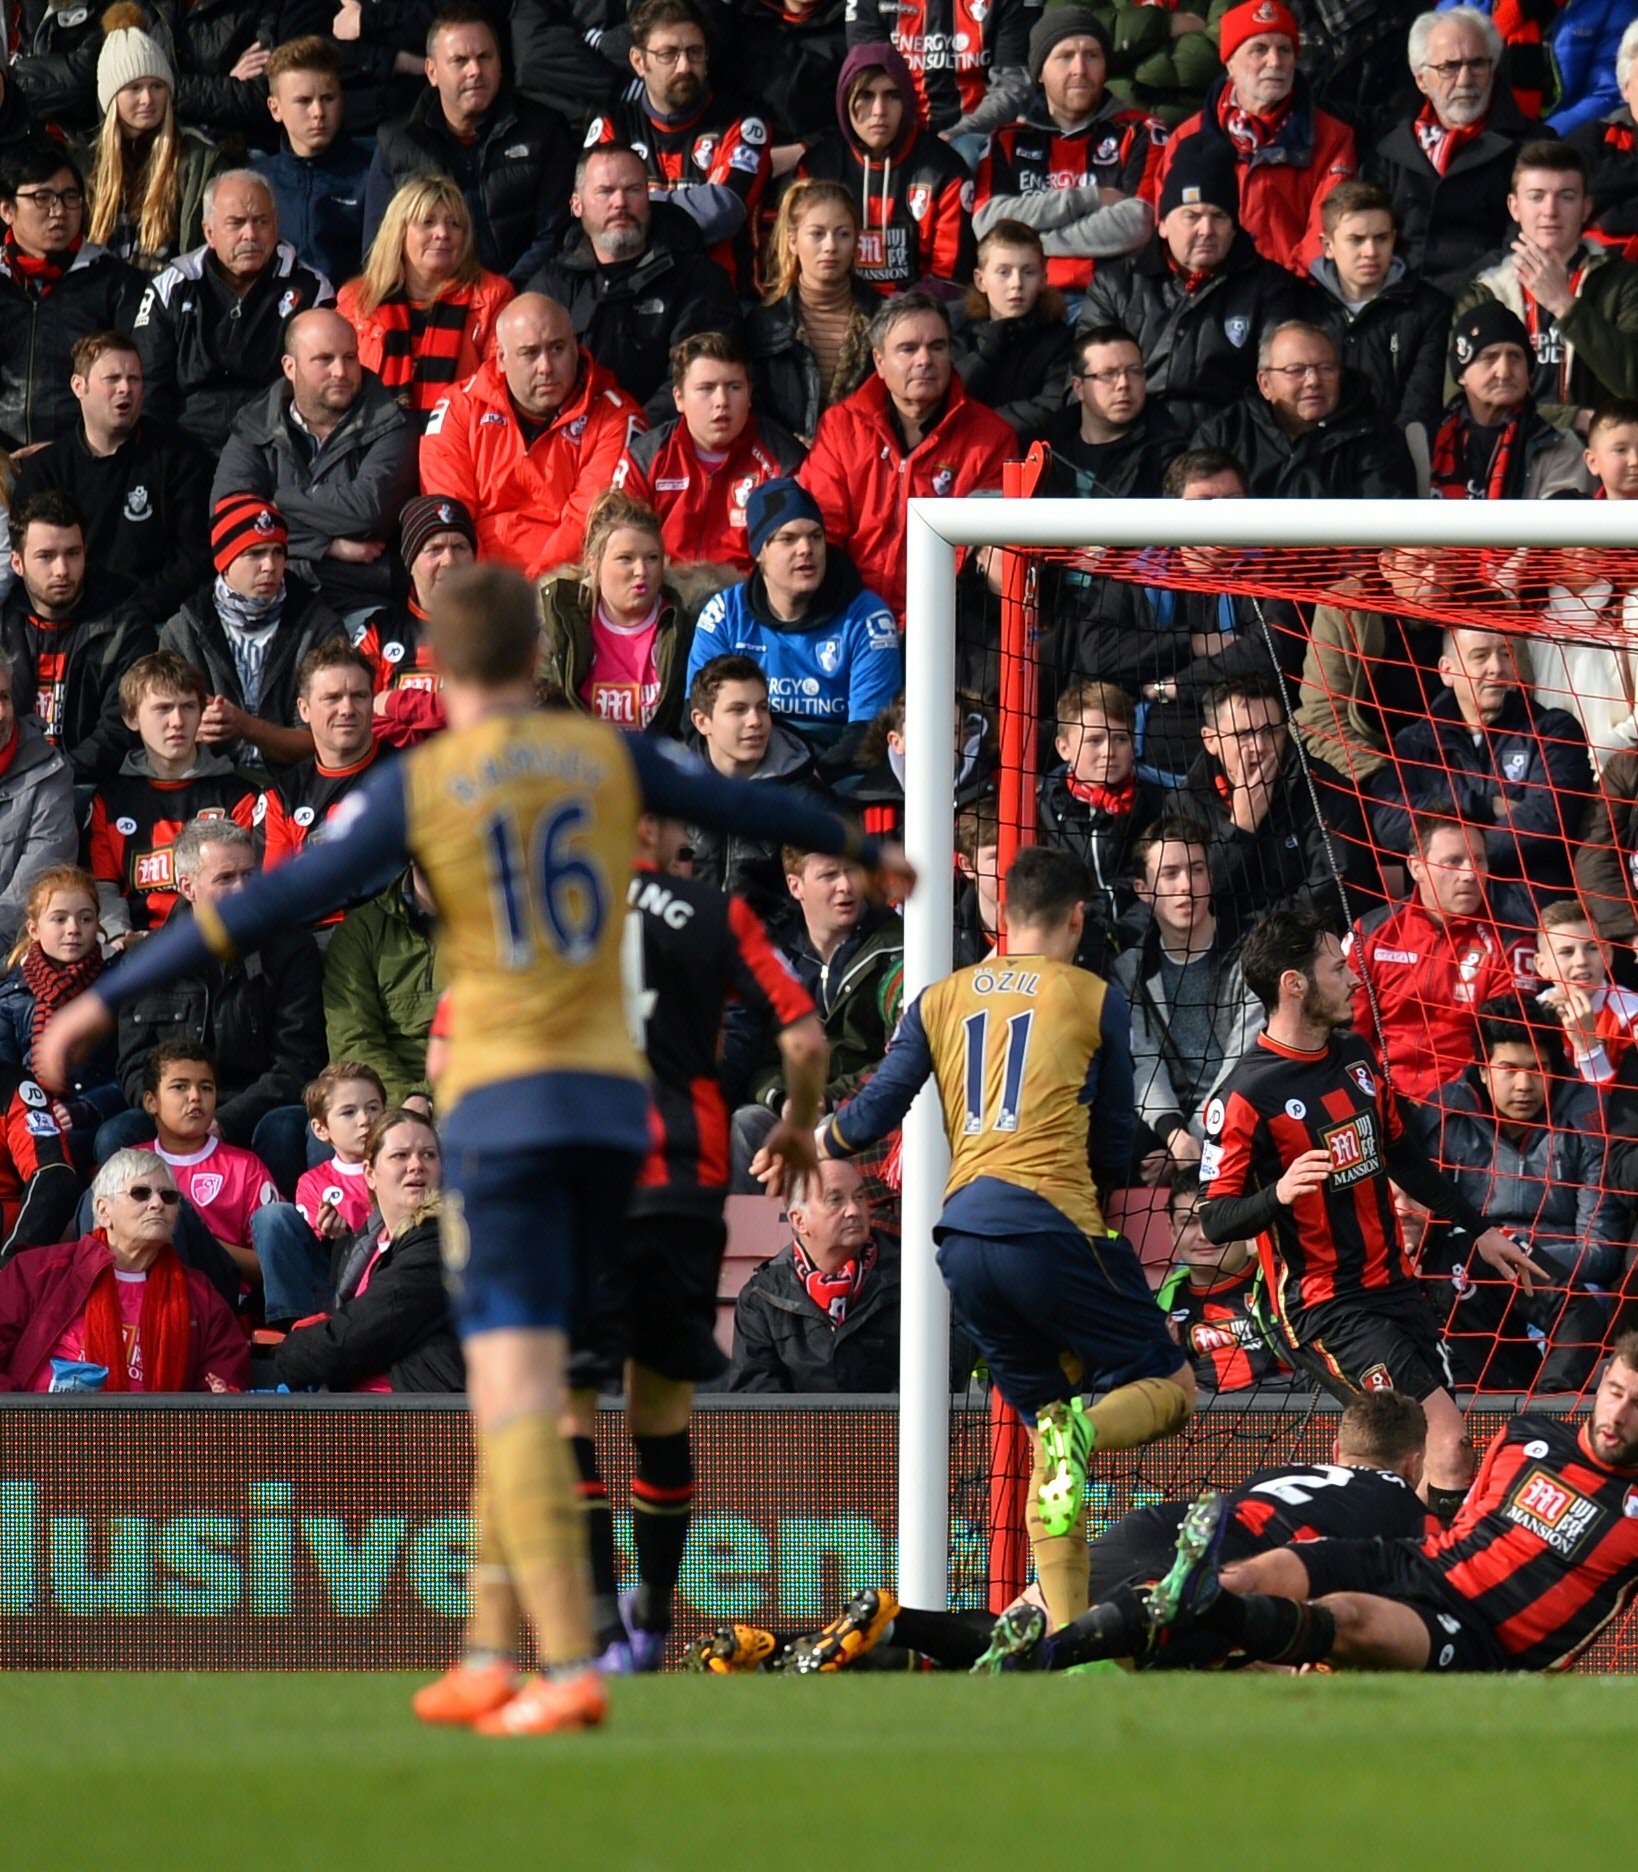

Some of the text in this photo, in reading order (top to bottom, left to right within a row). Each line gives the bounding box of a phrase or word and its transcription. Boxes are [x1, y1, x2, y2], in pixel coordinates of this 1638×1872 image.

[903, 51, 992, 71] ONSULTING
[768, 677, 804, 697] RGY
[769, 698, 845, 715] SULTING
[482, 796, 613, 968] 16
[972, 967, 1041, 997] ÖZIL
[962, 1007, 1035, 1135] 11
[1333, 1156, 1381, 1187] MANSION
[1250, 1463, 1355, 1506] 2
[1506, 1504, 1575, 1555] MANSION
